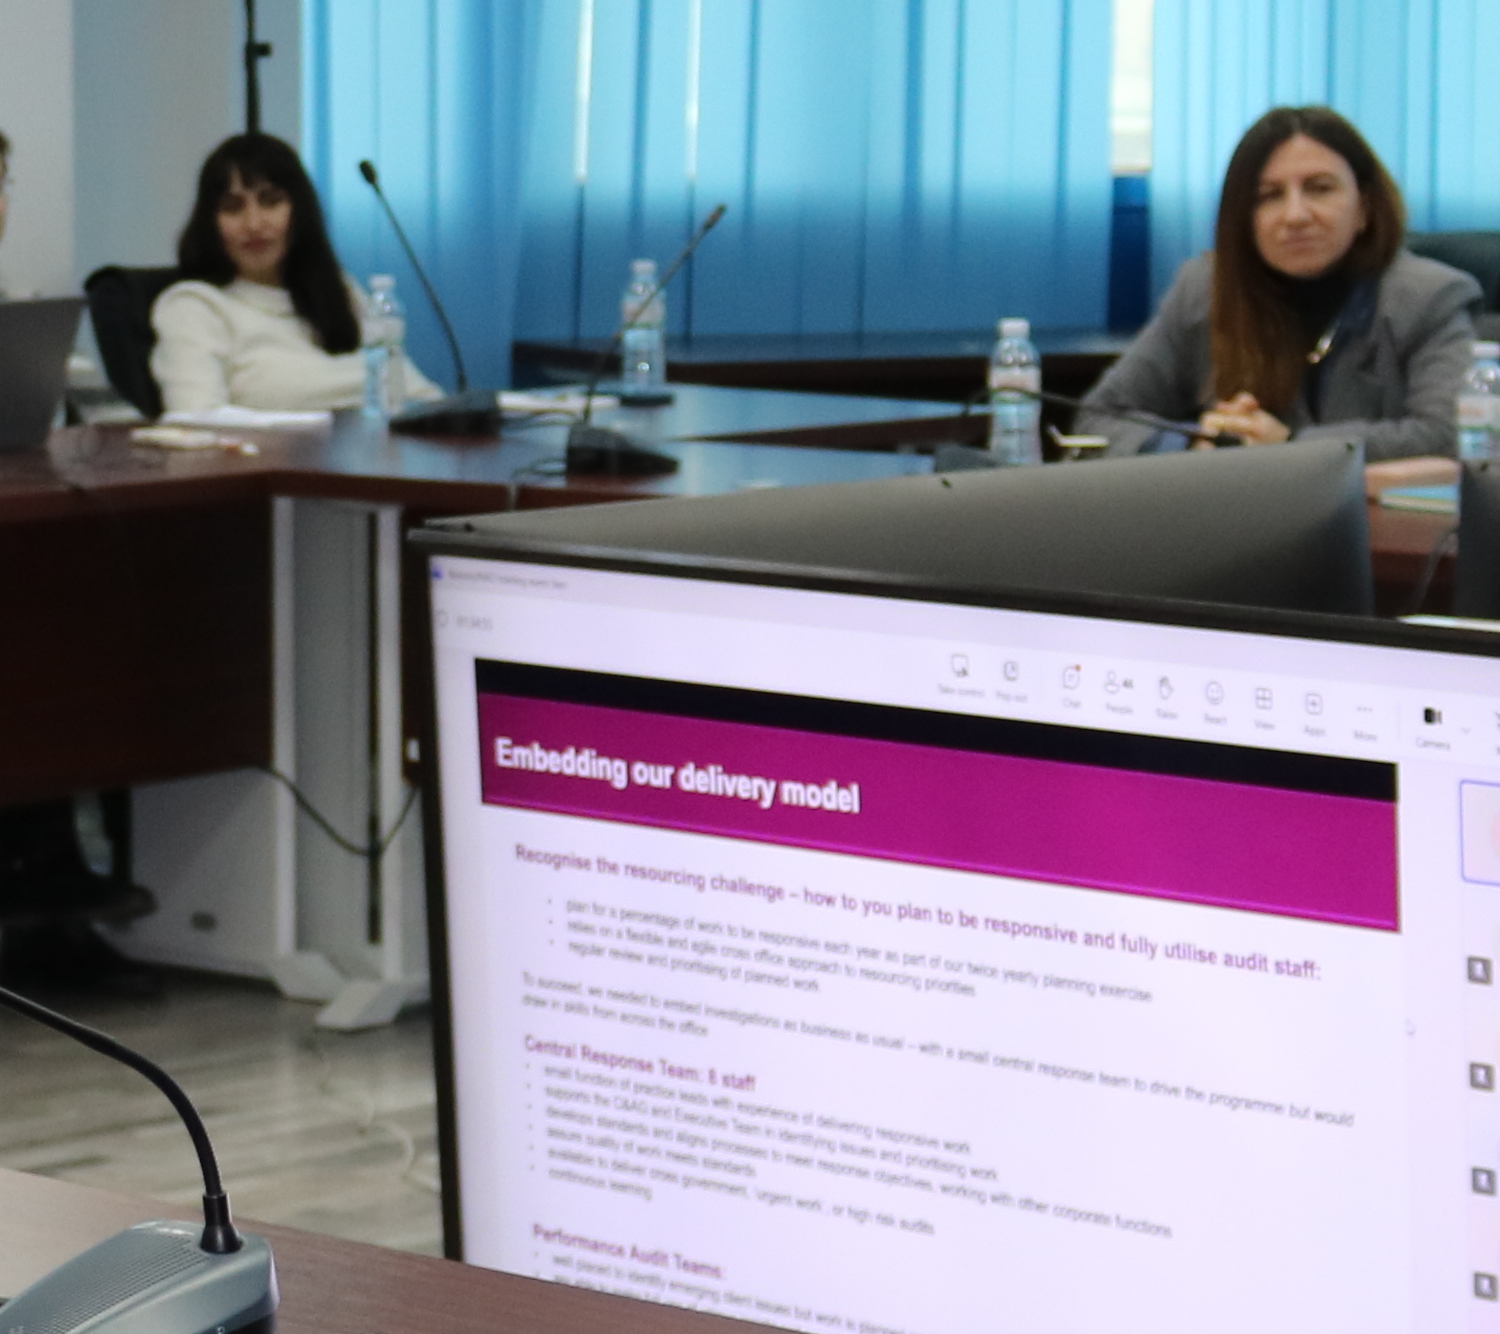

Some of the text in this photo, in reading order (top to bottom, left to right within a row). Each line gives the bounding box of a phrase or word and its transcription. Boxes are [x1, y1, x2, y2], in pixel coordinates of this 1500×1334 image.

[494, 737, 861, 815] Embedding our delivery model
[515, 844, 593, 871] Recognise
[595, 855, 620, 875] the
[622, 862, 706, 892] resourcing
[709, 873, 785, 902] challenge
[802, 885, 837, 907] how
[839, 892, 858, 910] to
[860, 898, 893, 917] you
[895, 900, 932, 922] plan
[935, 906, 954, 925] to
[956, 908, 979, 929] be
[982, 916, 1078, 943] responsive
[1081, 930, 1115, 949] and
[1118, 932, 1158, 960] fully
[1161, 941, 1217, 964] utilise
[1221, 950, 1269, 972] audit
[1272, 958, 1321, 980] staff:
